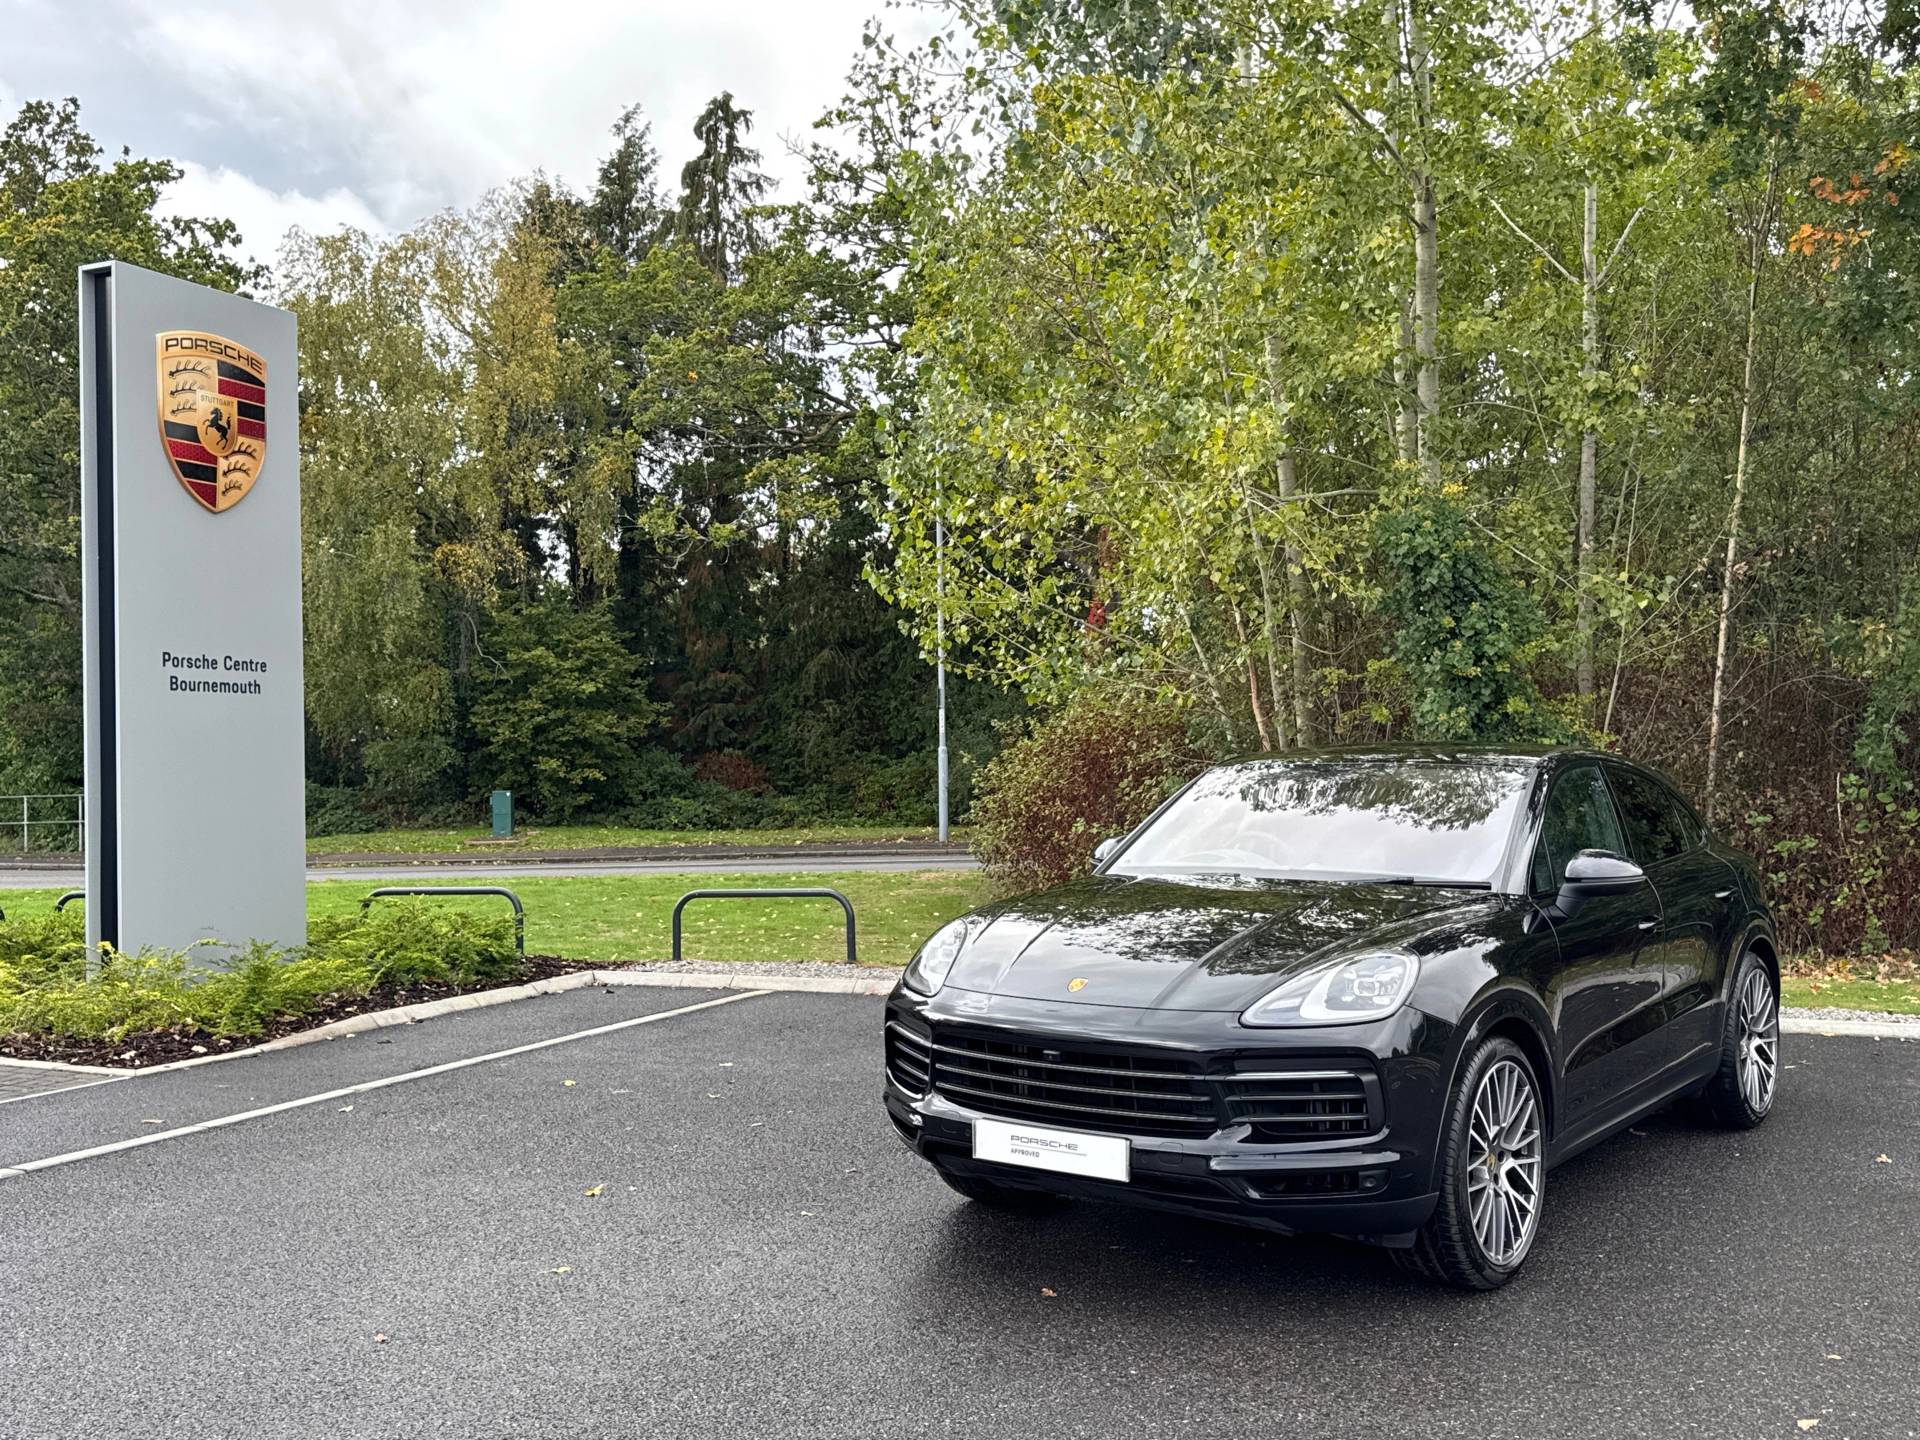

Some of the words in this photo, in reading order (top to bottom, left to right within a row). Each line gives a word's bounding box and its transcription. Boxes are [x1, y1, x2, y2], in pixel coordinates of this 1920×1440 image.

[165, 337, 263, 375] PORSCHE
[162, 651, 218, 670] Porsche
[223, 655, 267, 672] Centre
[169, 675, 261, 694] Bournemouth
[1010, 1135, 1078, 1151] PORSCHE
[1010, 1148, 1040, 1158] APPROVED
